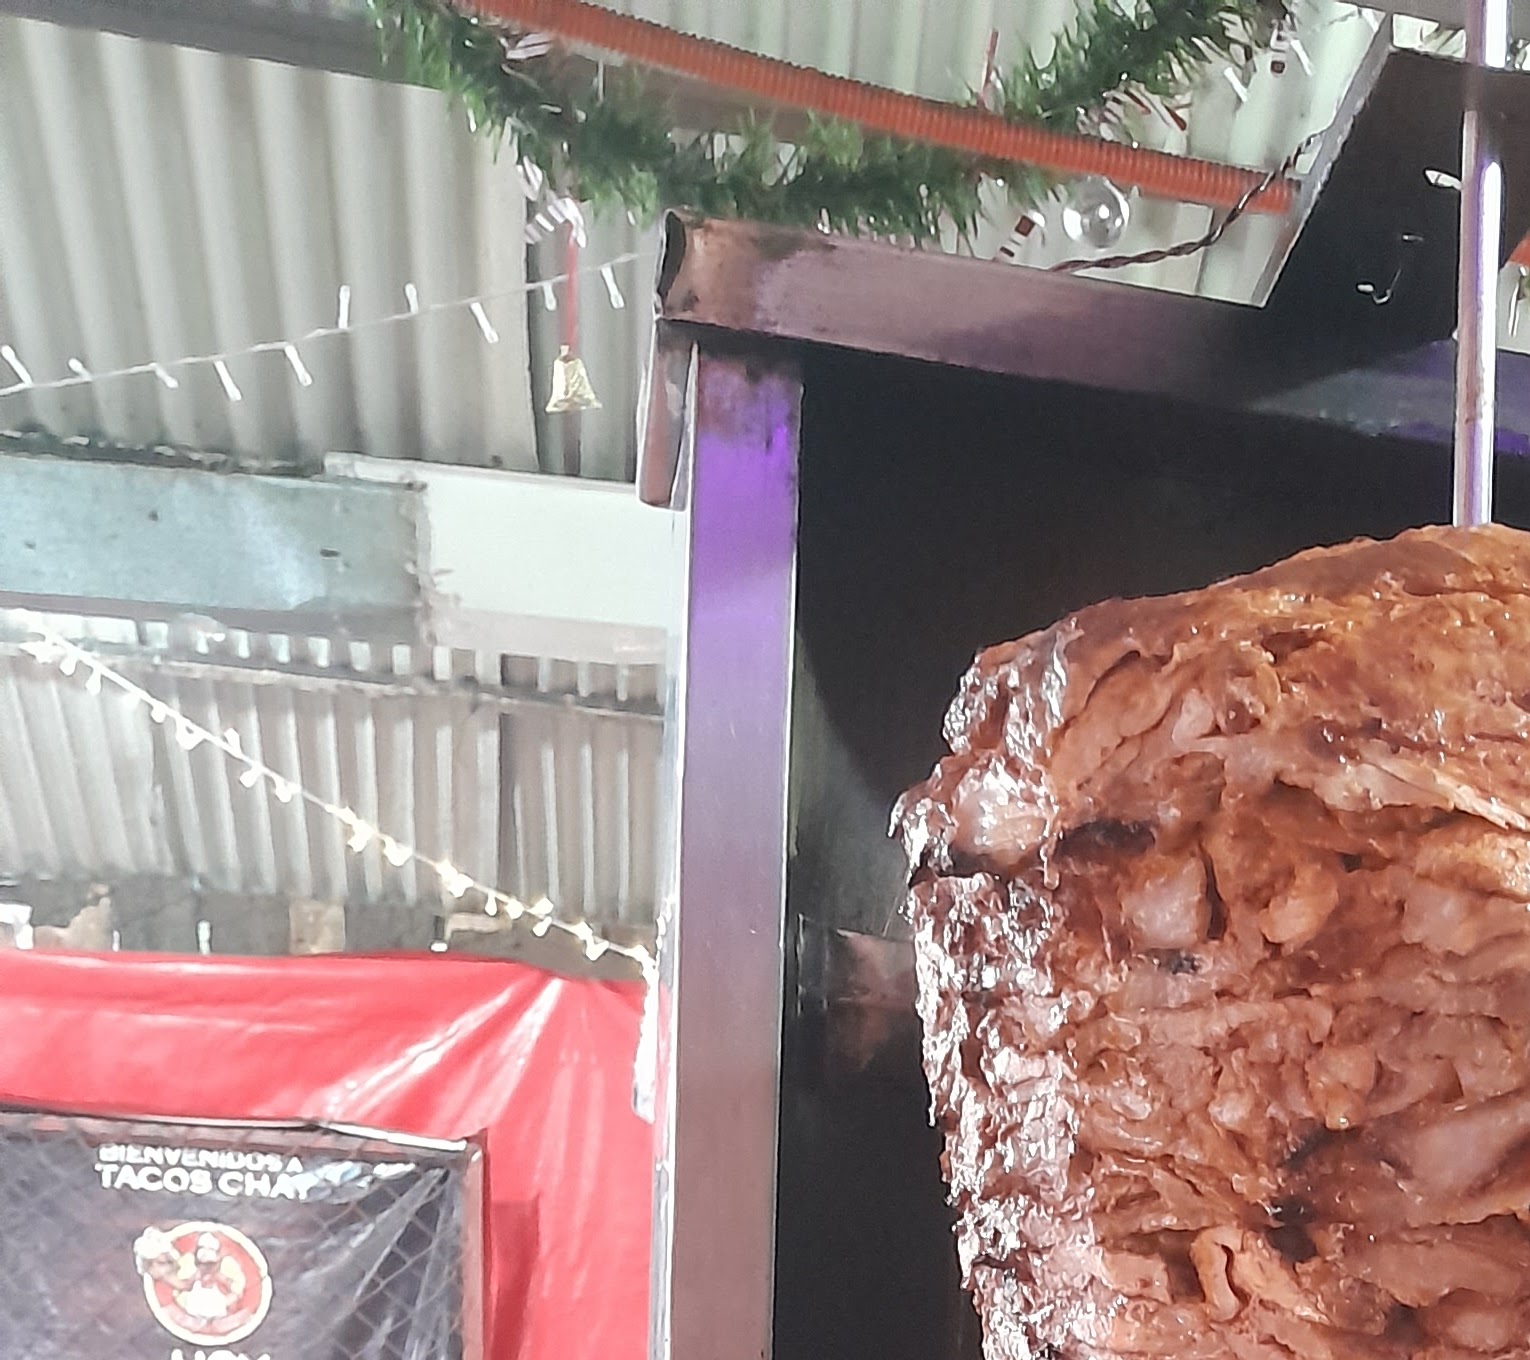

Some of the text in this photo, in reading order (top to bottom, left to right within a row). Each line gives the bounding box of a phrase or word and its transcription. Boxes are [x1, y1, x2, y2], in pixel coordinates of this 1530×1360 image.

[99, 1144, 304, 1174] BIENVENIDOS A
[95, 1163, 213, 1195] TACOS
